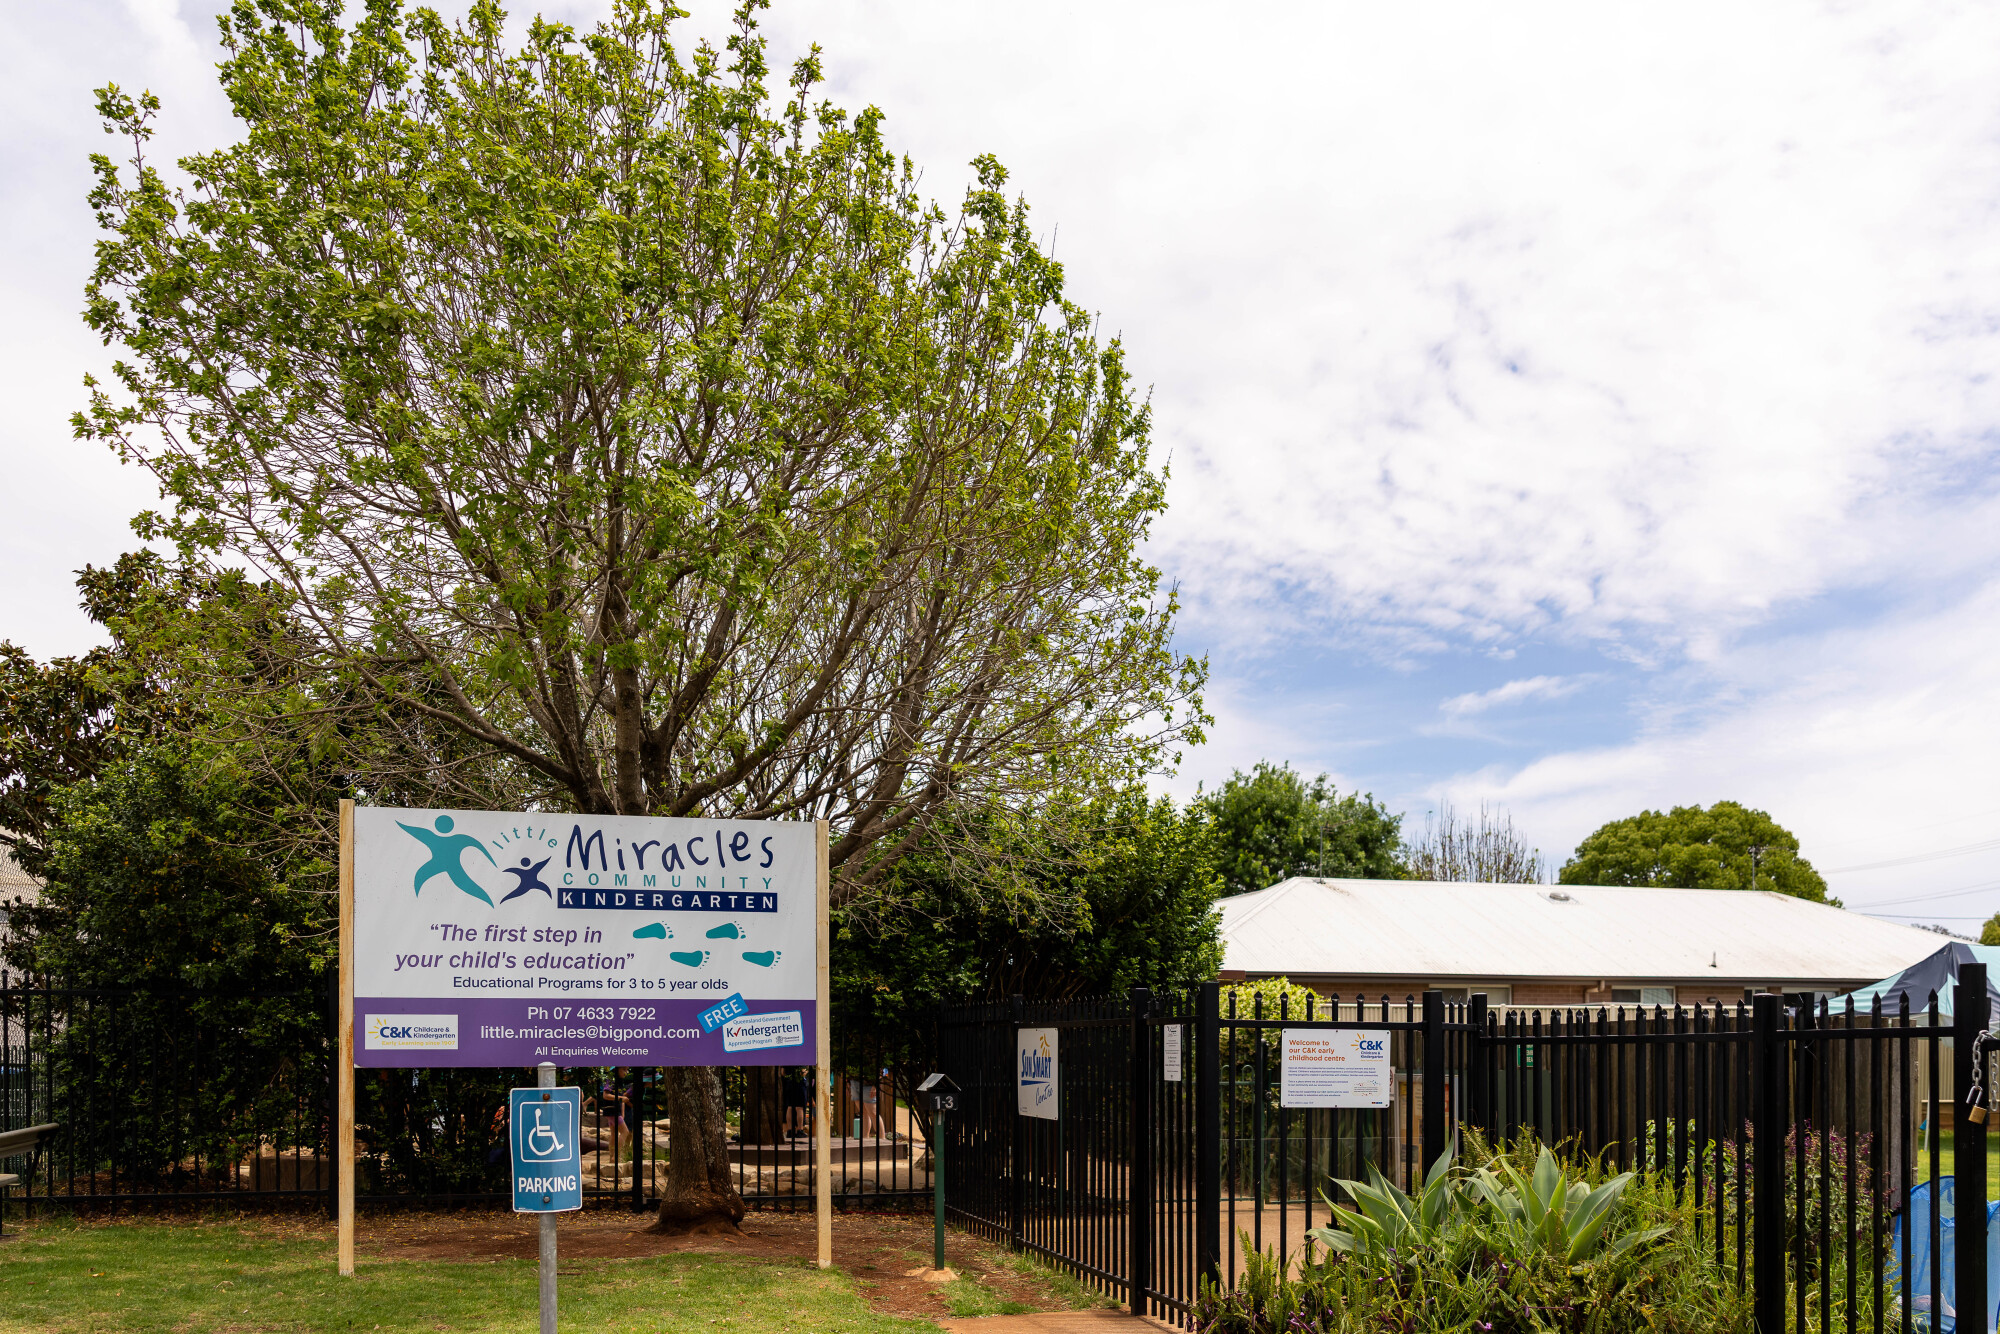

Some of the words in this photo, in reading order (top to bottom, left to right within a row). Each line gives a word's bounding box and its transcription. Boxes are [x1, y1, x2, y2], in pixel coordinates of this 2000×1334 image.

[492, 826, 558, 849] little
[566, 824, 774, 872] Miracles
[562, 872, 773, 889] COMMUNITY
[562, 892, 773, 909] KINDERGARTEN
[484, 924, 528, 942] first
[533, 926, 577, 946] step
[584, 926, 602, 943] in
[394, 954, 443, 971] your
[449, 952, 517, 969] child's
[453, 977, 534, 989] Educational
[538, 977, 603, 991] Programs
[606, 977, 626, 990] for
[629, 978, 638, 990] 3
[641, 979, 654, 990] to
[658, 979, 666, 990] 5
[669, 981, 698, 992] year
[701, 978, 728, 990] olds
[527, 1006, 549, 1020] Ph
[553, 1007, 572, 1020] 07
[577, 1007, 614, 1020] 4633
[619, 1007, 656, 1020] 7922
[704, 999, 742, 1028] FREE
[733, 1016, 762, 1025] Queensland
[762, 1015, 791, 1023] Government
[380, 1026, 412, 1038] C&K
[480, 1025, 700, 1042] little.miracles@bigpond.com
[728, 1039, 751, 1047] Approved
[1359, 1040, 1383, 1051] C&K
[535, 1047, 548, 1056] All
[551, 1047, 598, 1057] Enquiries
[601, 1047, 649, 1056] Welcome
[935, 1096, 954, 1110] 1-3
[518, 1175, 577, 1193] PARKING
